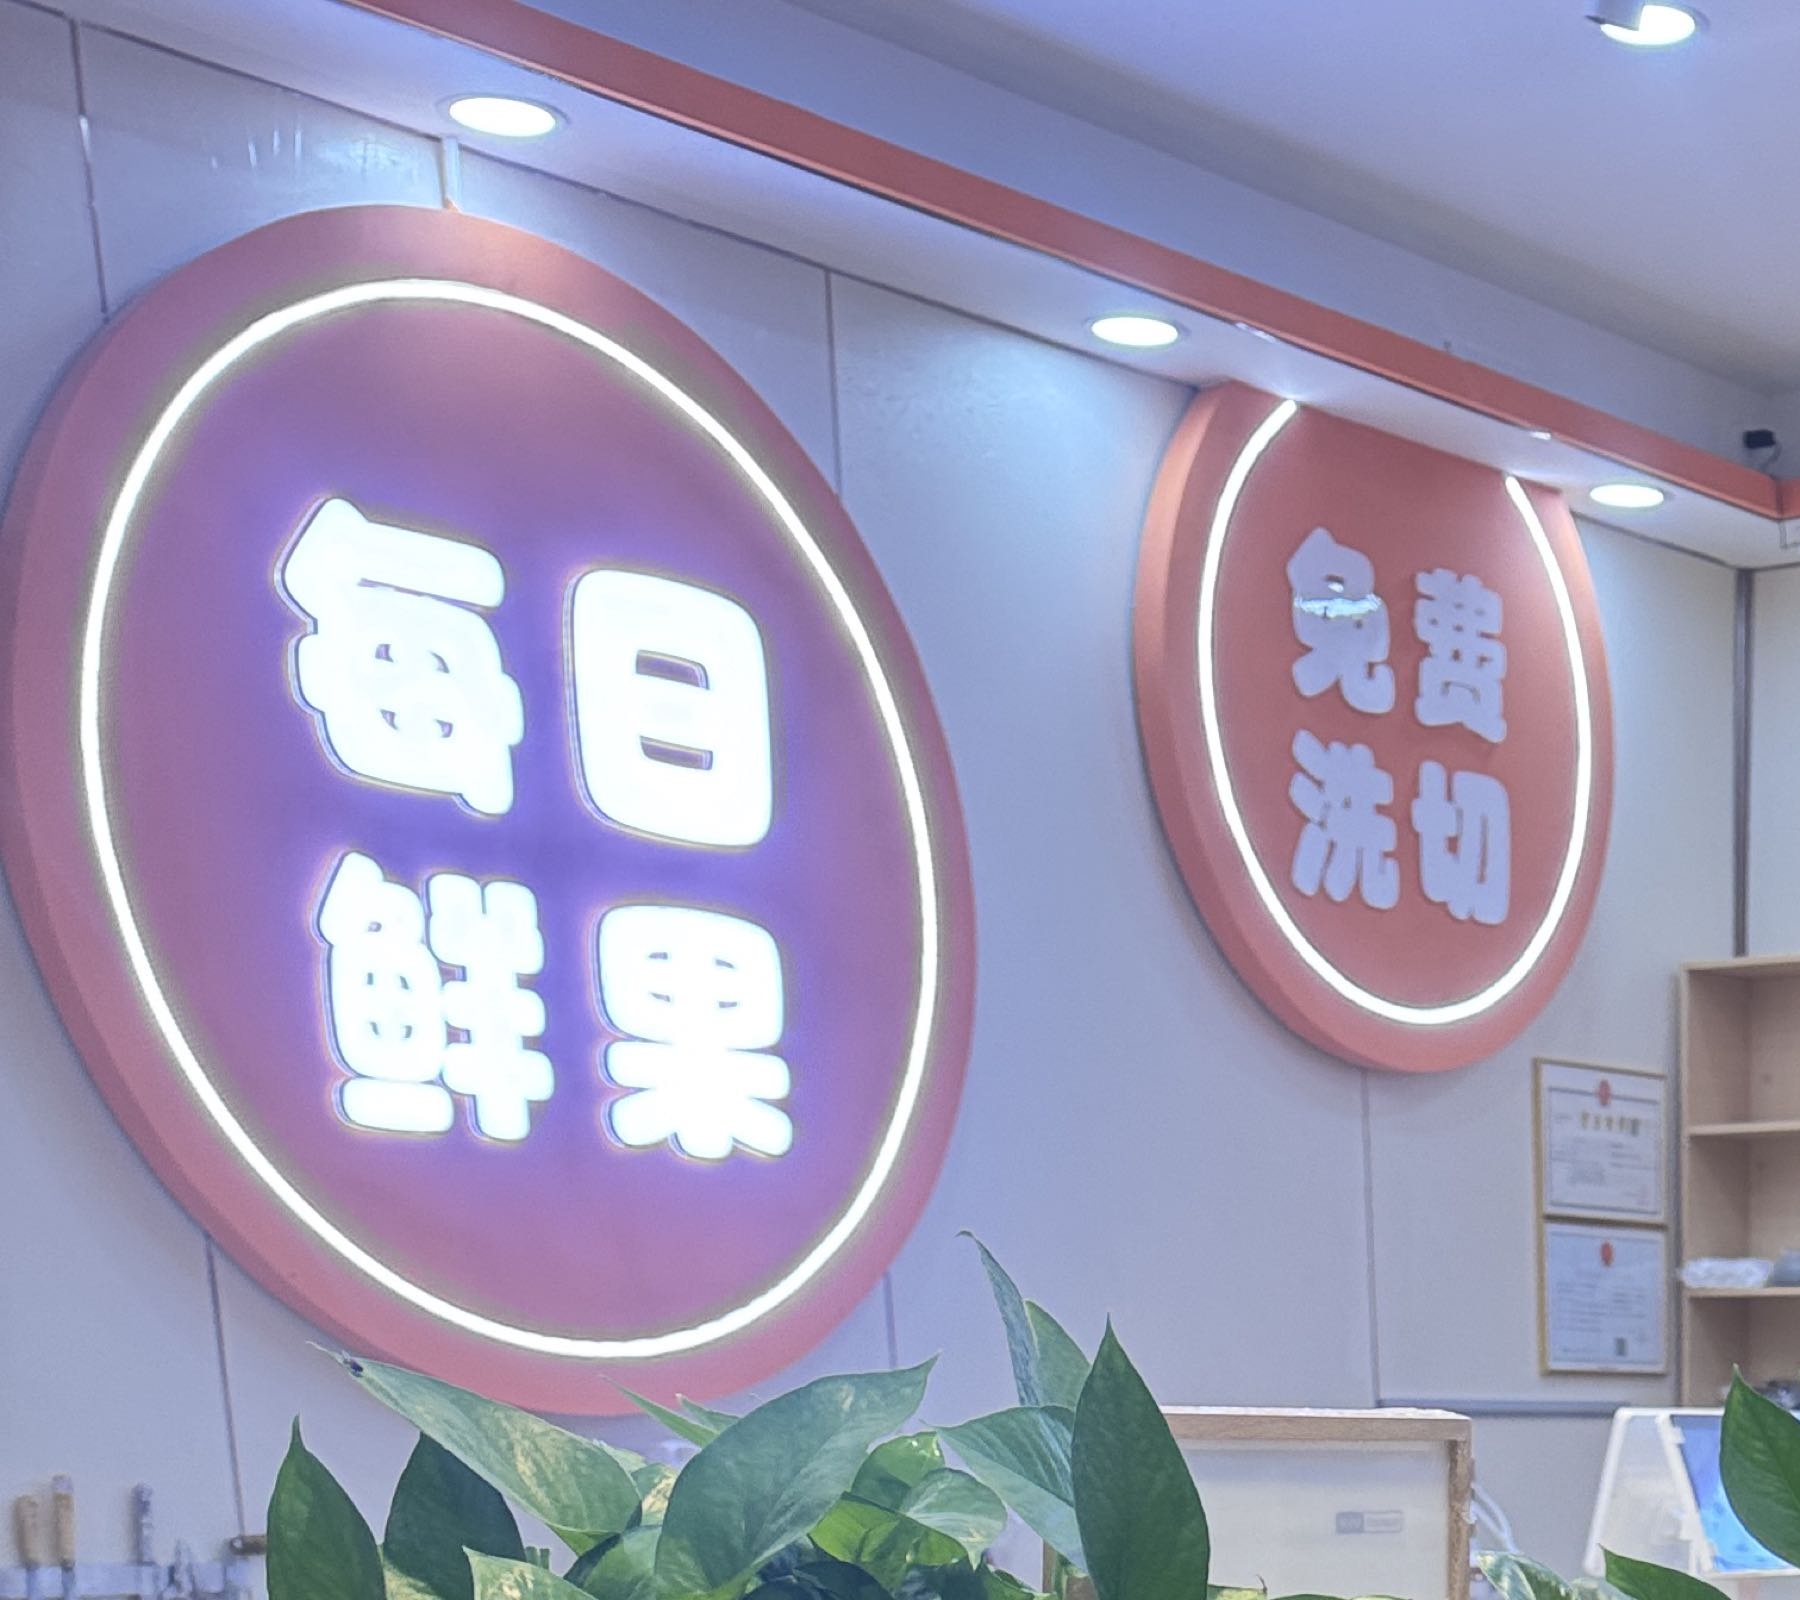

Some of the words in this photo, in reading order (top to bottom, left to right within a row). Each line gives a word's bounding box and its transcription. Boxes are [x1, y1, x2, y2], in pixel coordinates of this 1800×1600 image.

[276, 498, 773, 849] 每日
[1286, 527, 1507, 743] 免费
[1289, 729, 1511, 926] 洗切
[317, 851, 793, 1161] 鲜果
